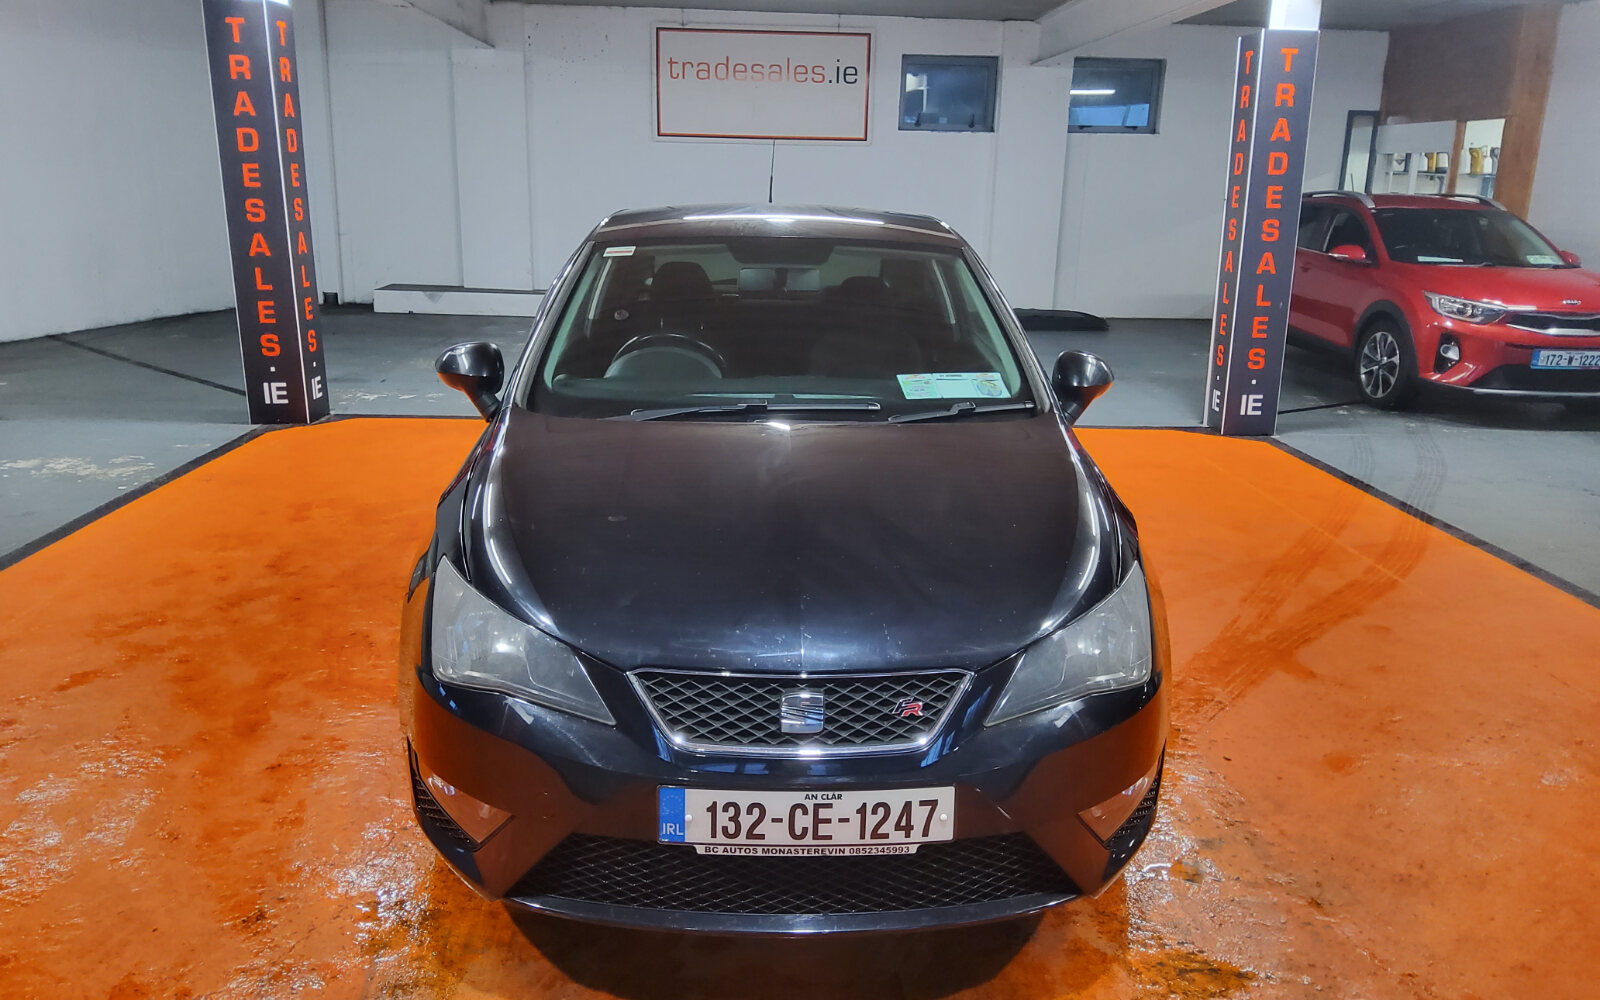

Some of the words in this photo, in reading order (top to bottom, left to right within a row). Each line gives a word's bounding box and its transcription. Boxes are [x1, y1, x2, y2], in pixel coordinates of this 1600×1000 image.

[667, 56, 859, 85] tradesales.ie
[804, 793, 818, 801] AN
[705, 798, 940, 841] 132-CE-1247
[662, 822, 684, 836] IRL
[704, 846, 719, 854] BC
[722, 846, 758, 854] AUTOS
[761, 847, 846, 855] MONASTEREVIN
[848, 845, 910, 855] 0852345993
